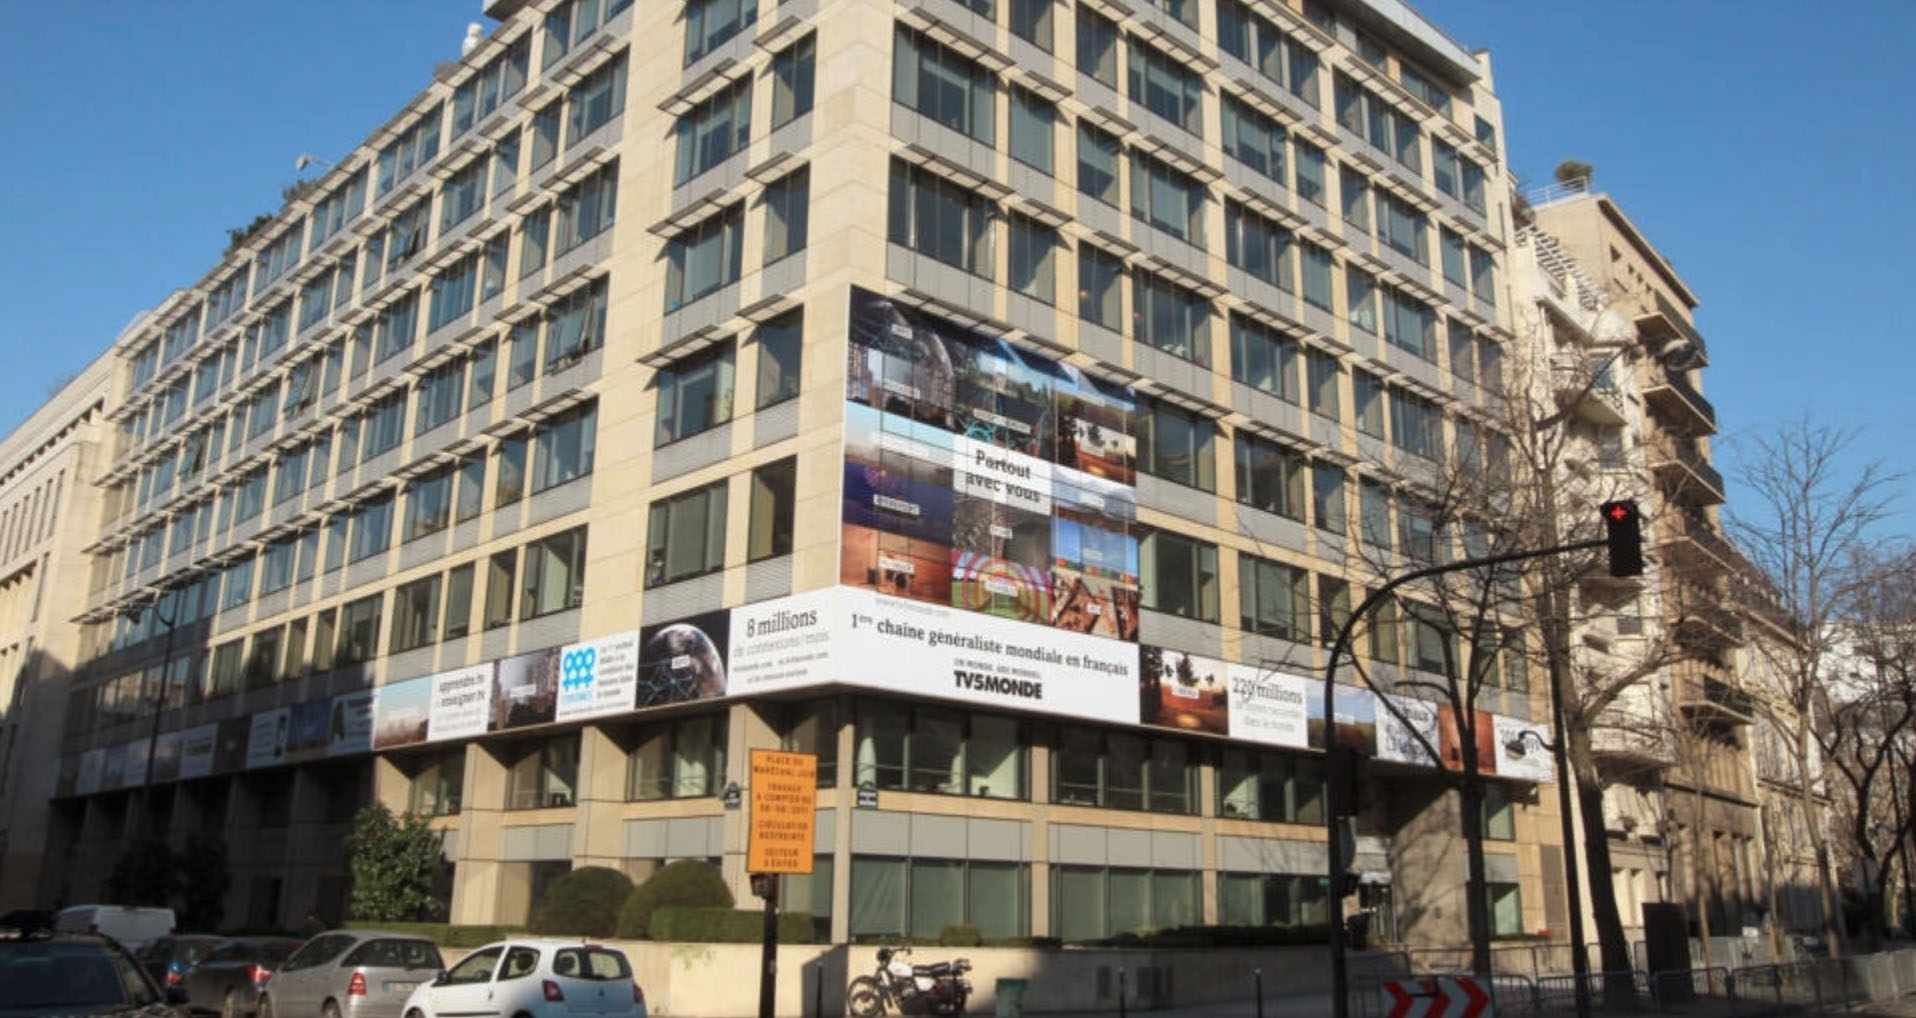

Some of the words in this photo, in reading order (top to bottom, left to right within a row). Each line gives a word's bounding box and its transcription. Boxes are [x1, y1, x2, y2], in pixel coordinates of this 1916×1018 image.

[974, 450, 1031, 480] Partout
[965, 470, 1001, 493] avec
[1005, 480, 1043, 503] vous
[757, 609, 818, 636] millions
[877, 615, 925, 641] chaîne
[928, 627, 1003, 655] généraliste
[1005, 642, 1064, 667] mondiale
[1065, 655, 1081, 668] en
[1082, 654, 1129, 678] français
[953, 670, 1043, 699] TV5MONDE
[1256, 684, 1303, 704] millions
